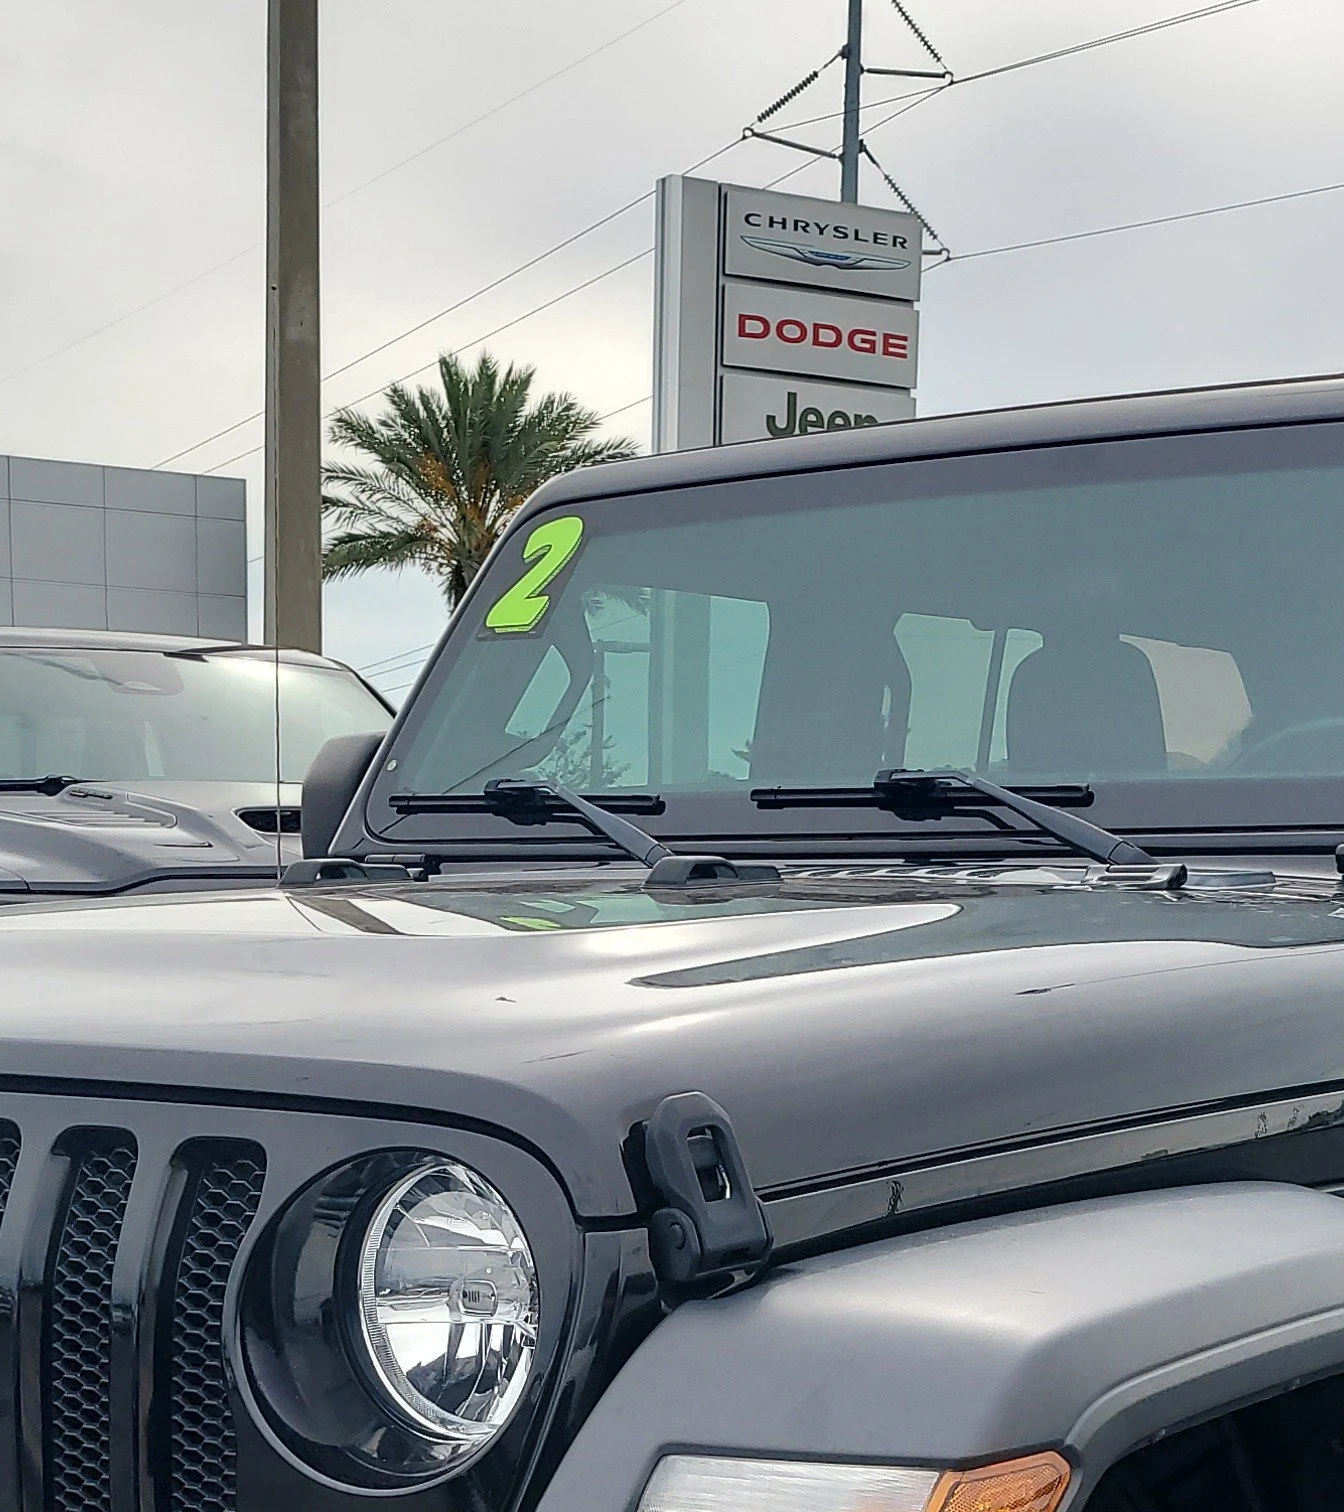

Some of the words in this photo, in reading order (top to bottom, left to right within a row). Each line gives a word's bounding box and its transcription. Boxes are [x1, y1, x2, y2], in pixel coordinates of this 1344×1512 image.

[744, 212, 909, 250] CHRYSLER
[737, 313, 909, 359] DODGE
[485, 515, 586, 634] 2
